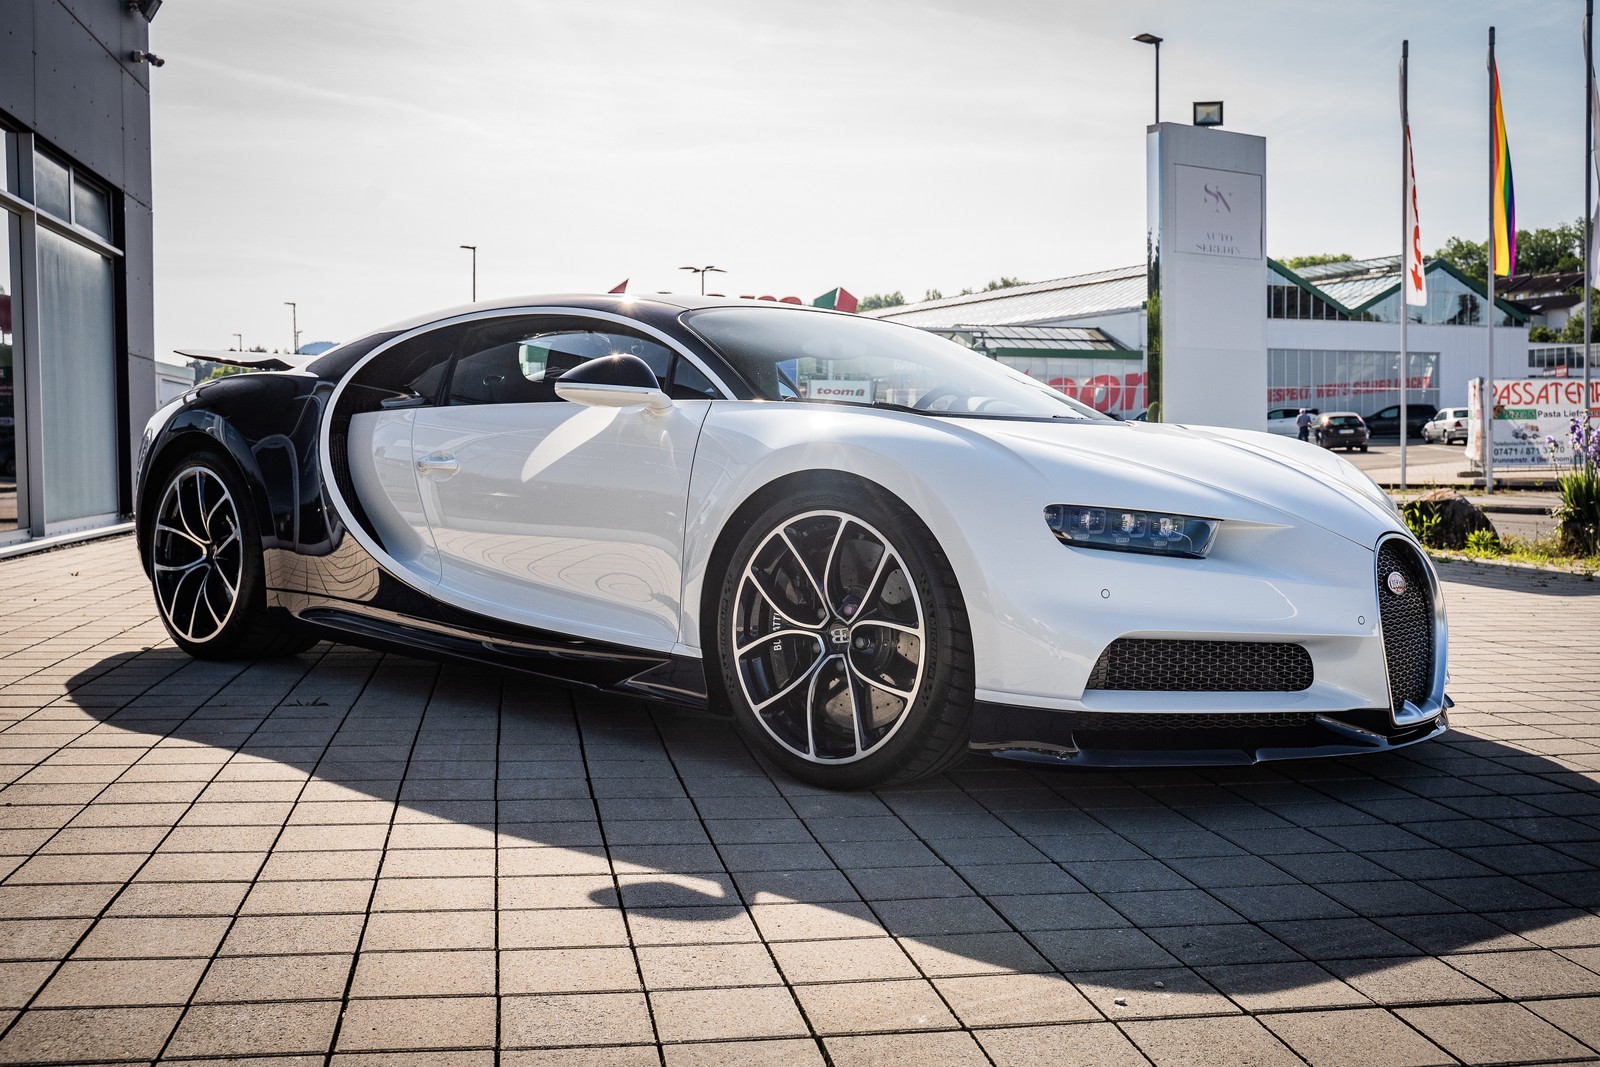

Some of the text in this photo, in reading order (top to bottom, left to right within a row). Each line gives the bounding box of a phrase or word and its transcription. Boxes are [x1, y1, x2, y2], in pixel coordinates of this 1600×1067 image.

[1206, 232, 1233, 242] AUTO
[816, 387, 854, 397] toom
[1538, 410, 1560, 418] Pasta
[1493, 448, 1518, 456] 07471
[1525, 447, 1540, 455] 871
[773, 612, 782, 651] BUATTI
